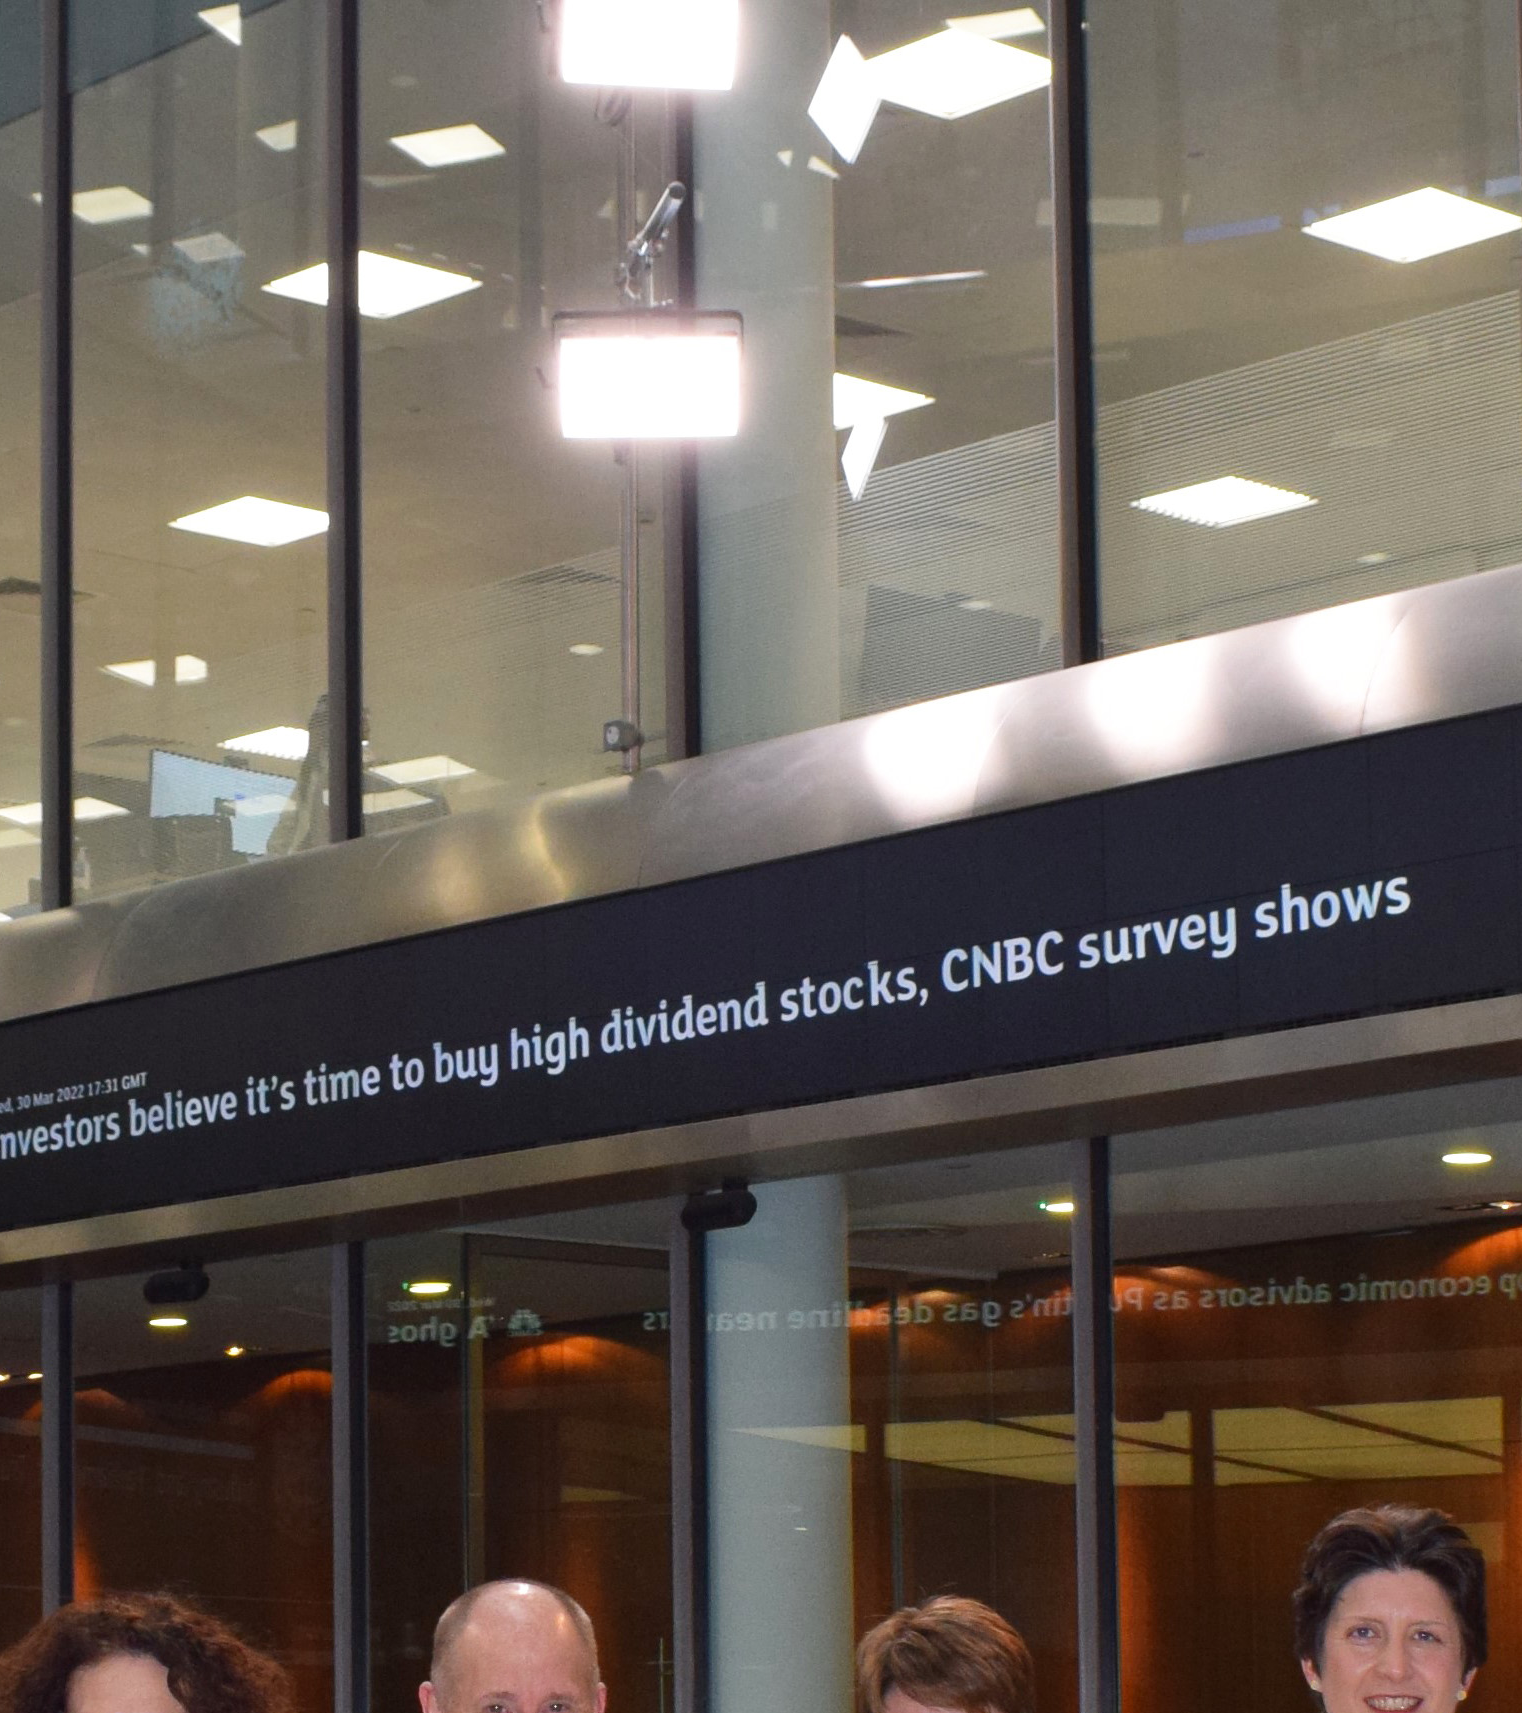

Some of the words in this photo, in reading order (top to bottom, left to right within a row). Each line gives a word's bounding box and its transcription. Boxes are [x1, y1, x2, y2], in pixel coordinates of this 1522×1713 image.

[129, 1087, 237, 1137] believe
[304, 1064, 380, 1105] time
[389, 1054, 424, 1090] to
[433, 1042, 498, 1086] buy
[511, 1017, 589, 1075] high
[601, 982, 769, 1053] dividend
[780, 961, 928, 1021] stocks,
[942, 931, 1063, 992] CNBC
[1079, 908, 1236, 968] survey
[1255, 877, 1410, 938] shows
[17, 1095, 31, 1110] 30
[33, 1093, 54, 1106] Mar
[57, 1084, 84, 1102] 2022
[88, 1078, 118, 1096] 17:31
[122, 1072, 147, 1089] GMT
